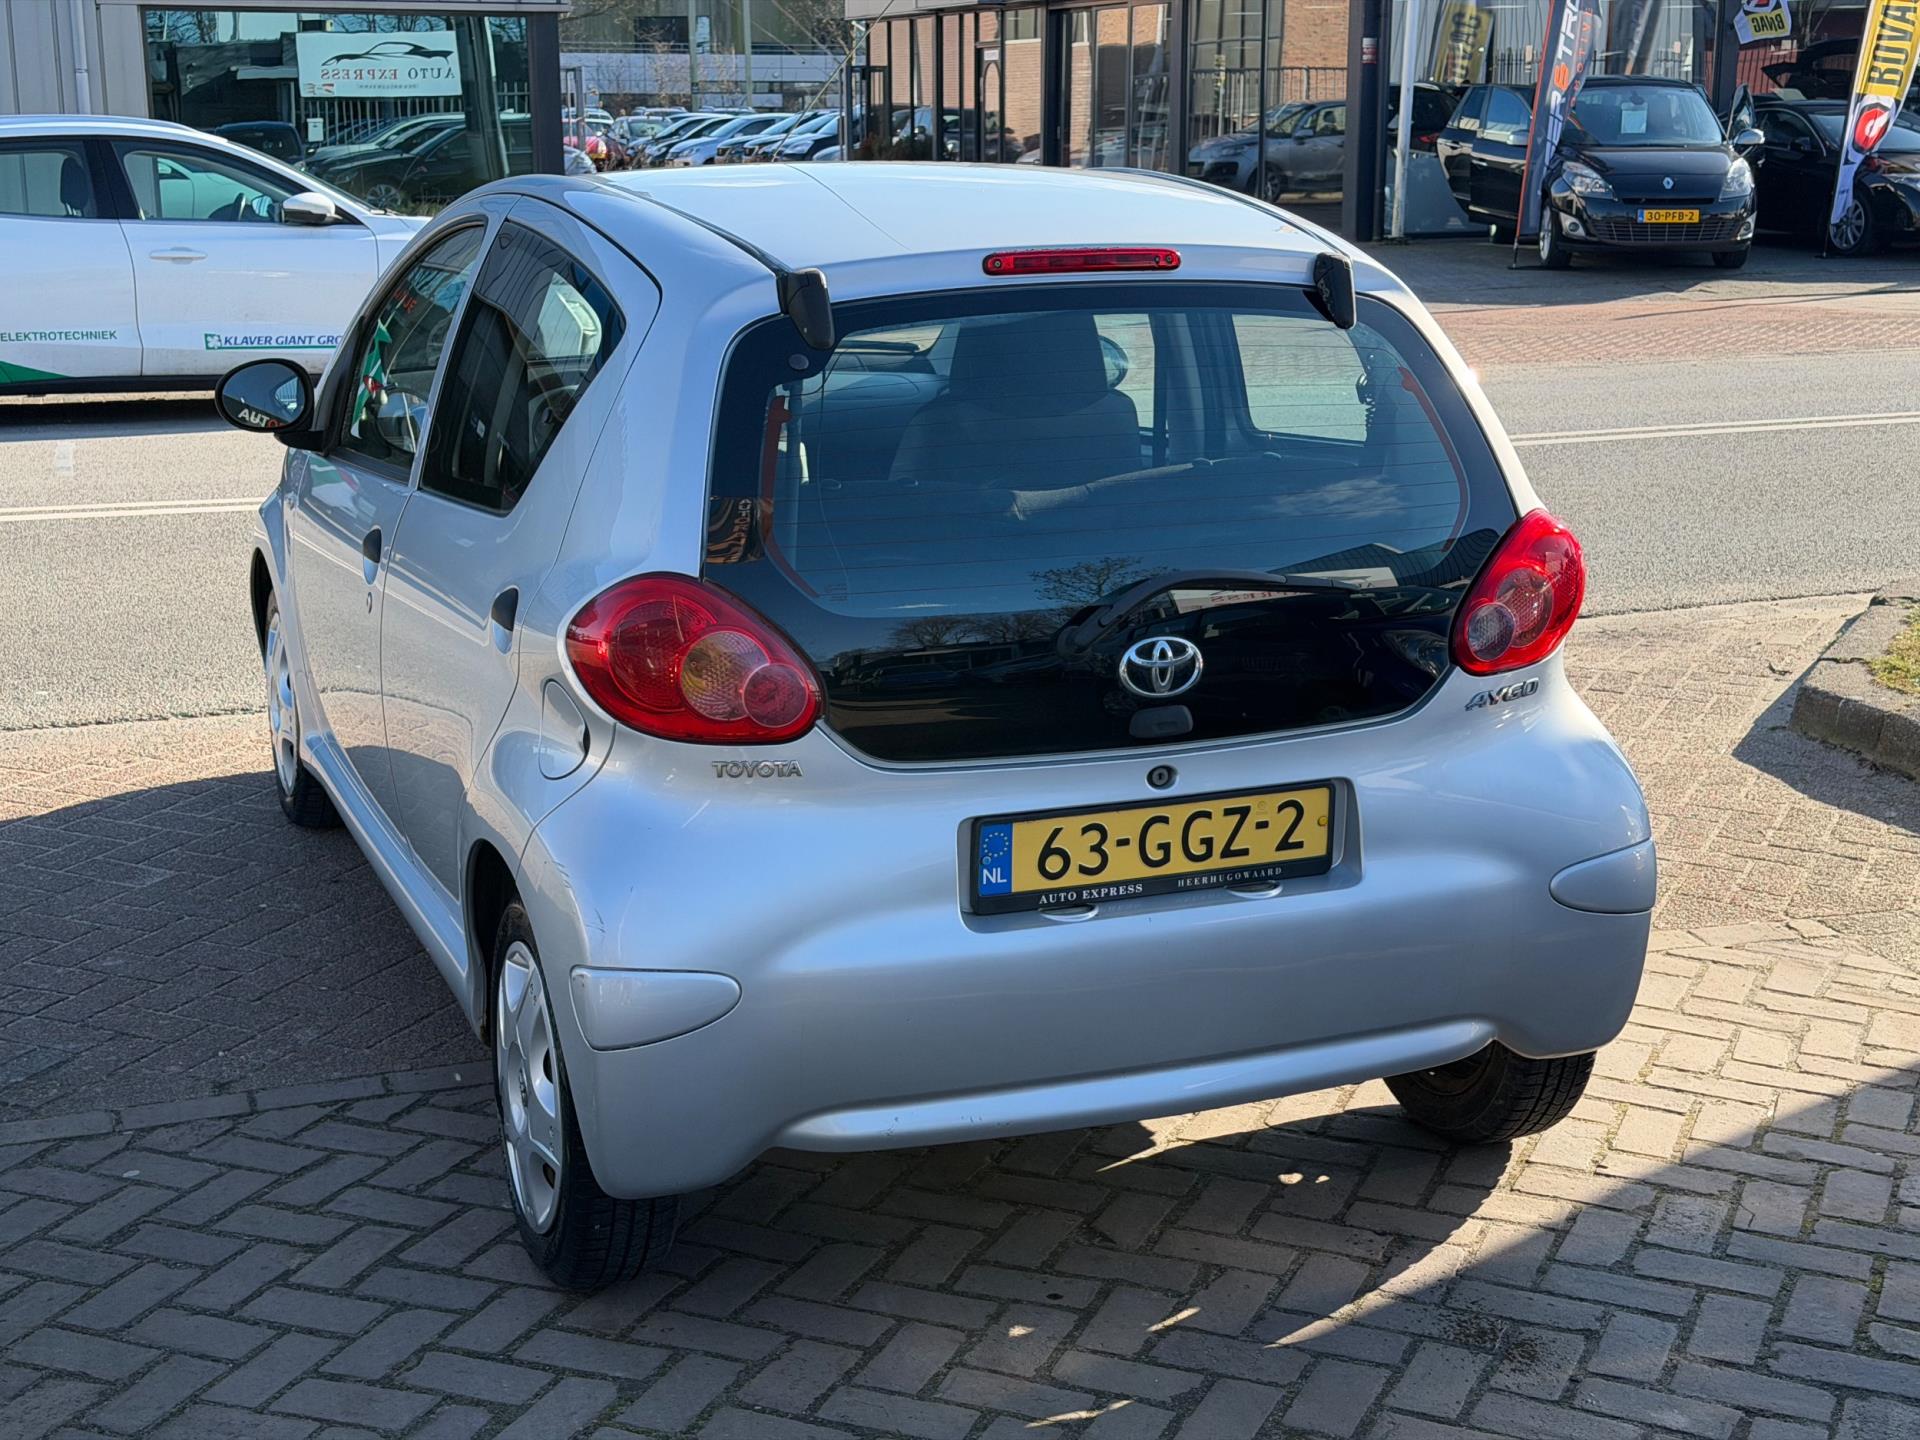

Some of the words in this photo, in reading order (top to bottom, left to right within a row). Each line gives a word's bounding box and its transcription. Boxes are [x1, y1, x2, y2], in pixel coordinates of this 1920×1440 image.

[1869, 0, 1918, 87] BOVA
[0, 330, 118, 342] ELEKTROTECHNIEK
[224, 335, 273, 346] KLAVER
[275, 335, 315, 345] GIANT
[711, 760, 803, 778] TOYOTA
[1036, 799, 1306, 881] 63-GGZ-2
[982, 867, 1007, 885] NL
[1177, 866, 1283, 888] HEERHUGOWAARD
[1038, 890, 1077, 905] AUTO
[1082, 883, 1144, 900] EXPRESS
